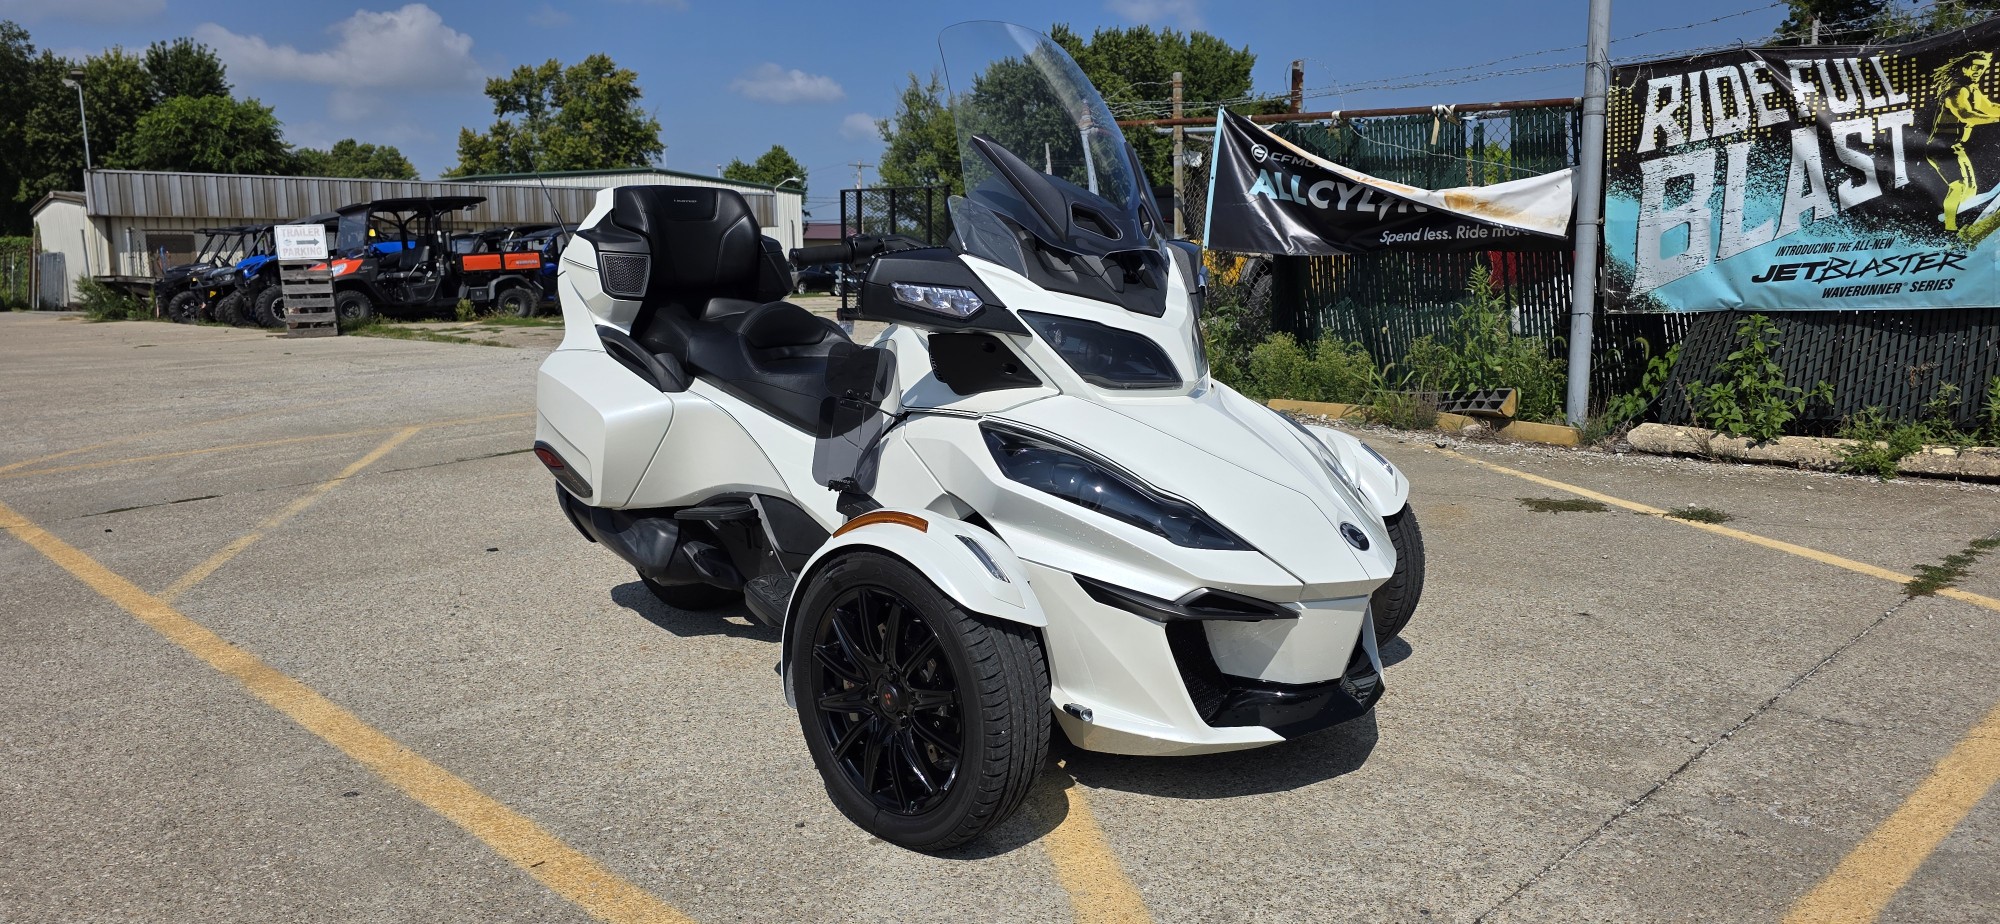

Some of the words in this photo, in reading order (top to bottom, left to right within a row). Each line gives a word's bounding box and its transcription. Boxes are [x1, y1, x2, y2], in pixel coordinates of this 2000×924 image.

[1637, 61, 1789, 153] RIDE
[1785, 57, 1908, 118] FULL
[1270, 152, 1321, 169] CFMO
[1628, 109, 1915, 298] BLAST
[281, 227, 320, 237] TRAILER
[1379, 227, 1422, 245] Spend
[1423, 227, 1452, 241] less.
[1456, 224, 1488, 239] Ride
[283, 247, 322, 256] PARKING
[1775, 242, 1835, 257] INTRODUCING
[1837, 242, 1852, 252] THE
[1851, 237, 1895, 251] ALL-NEW
[1909, 278, 1956, 293] SERIES
